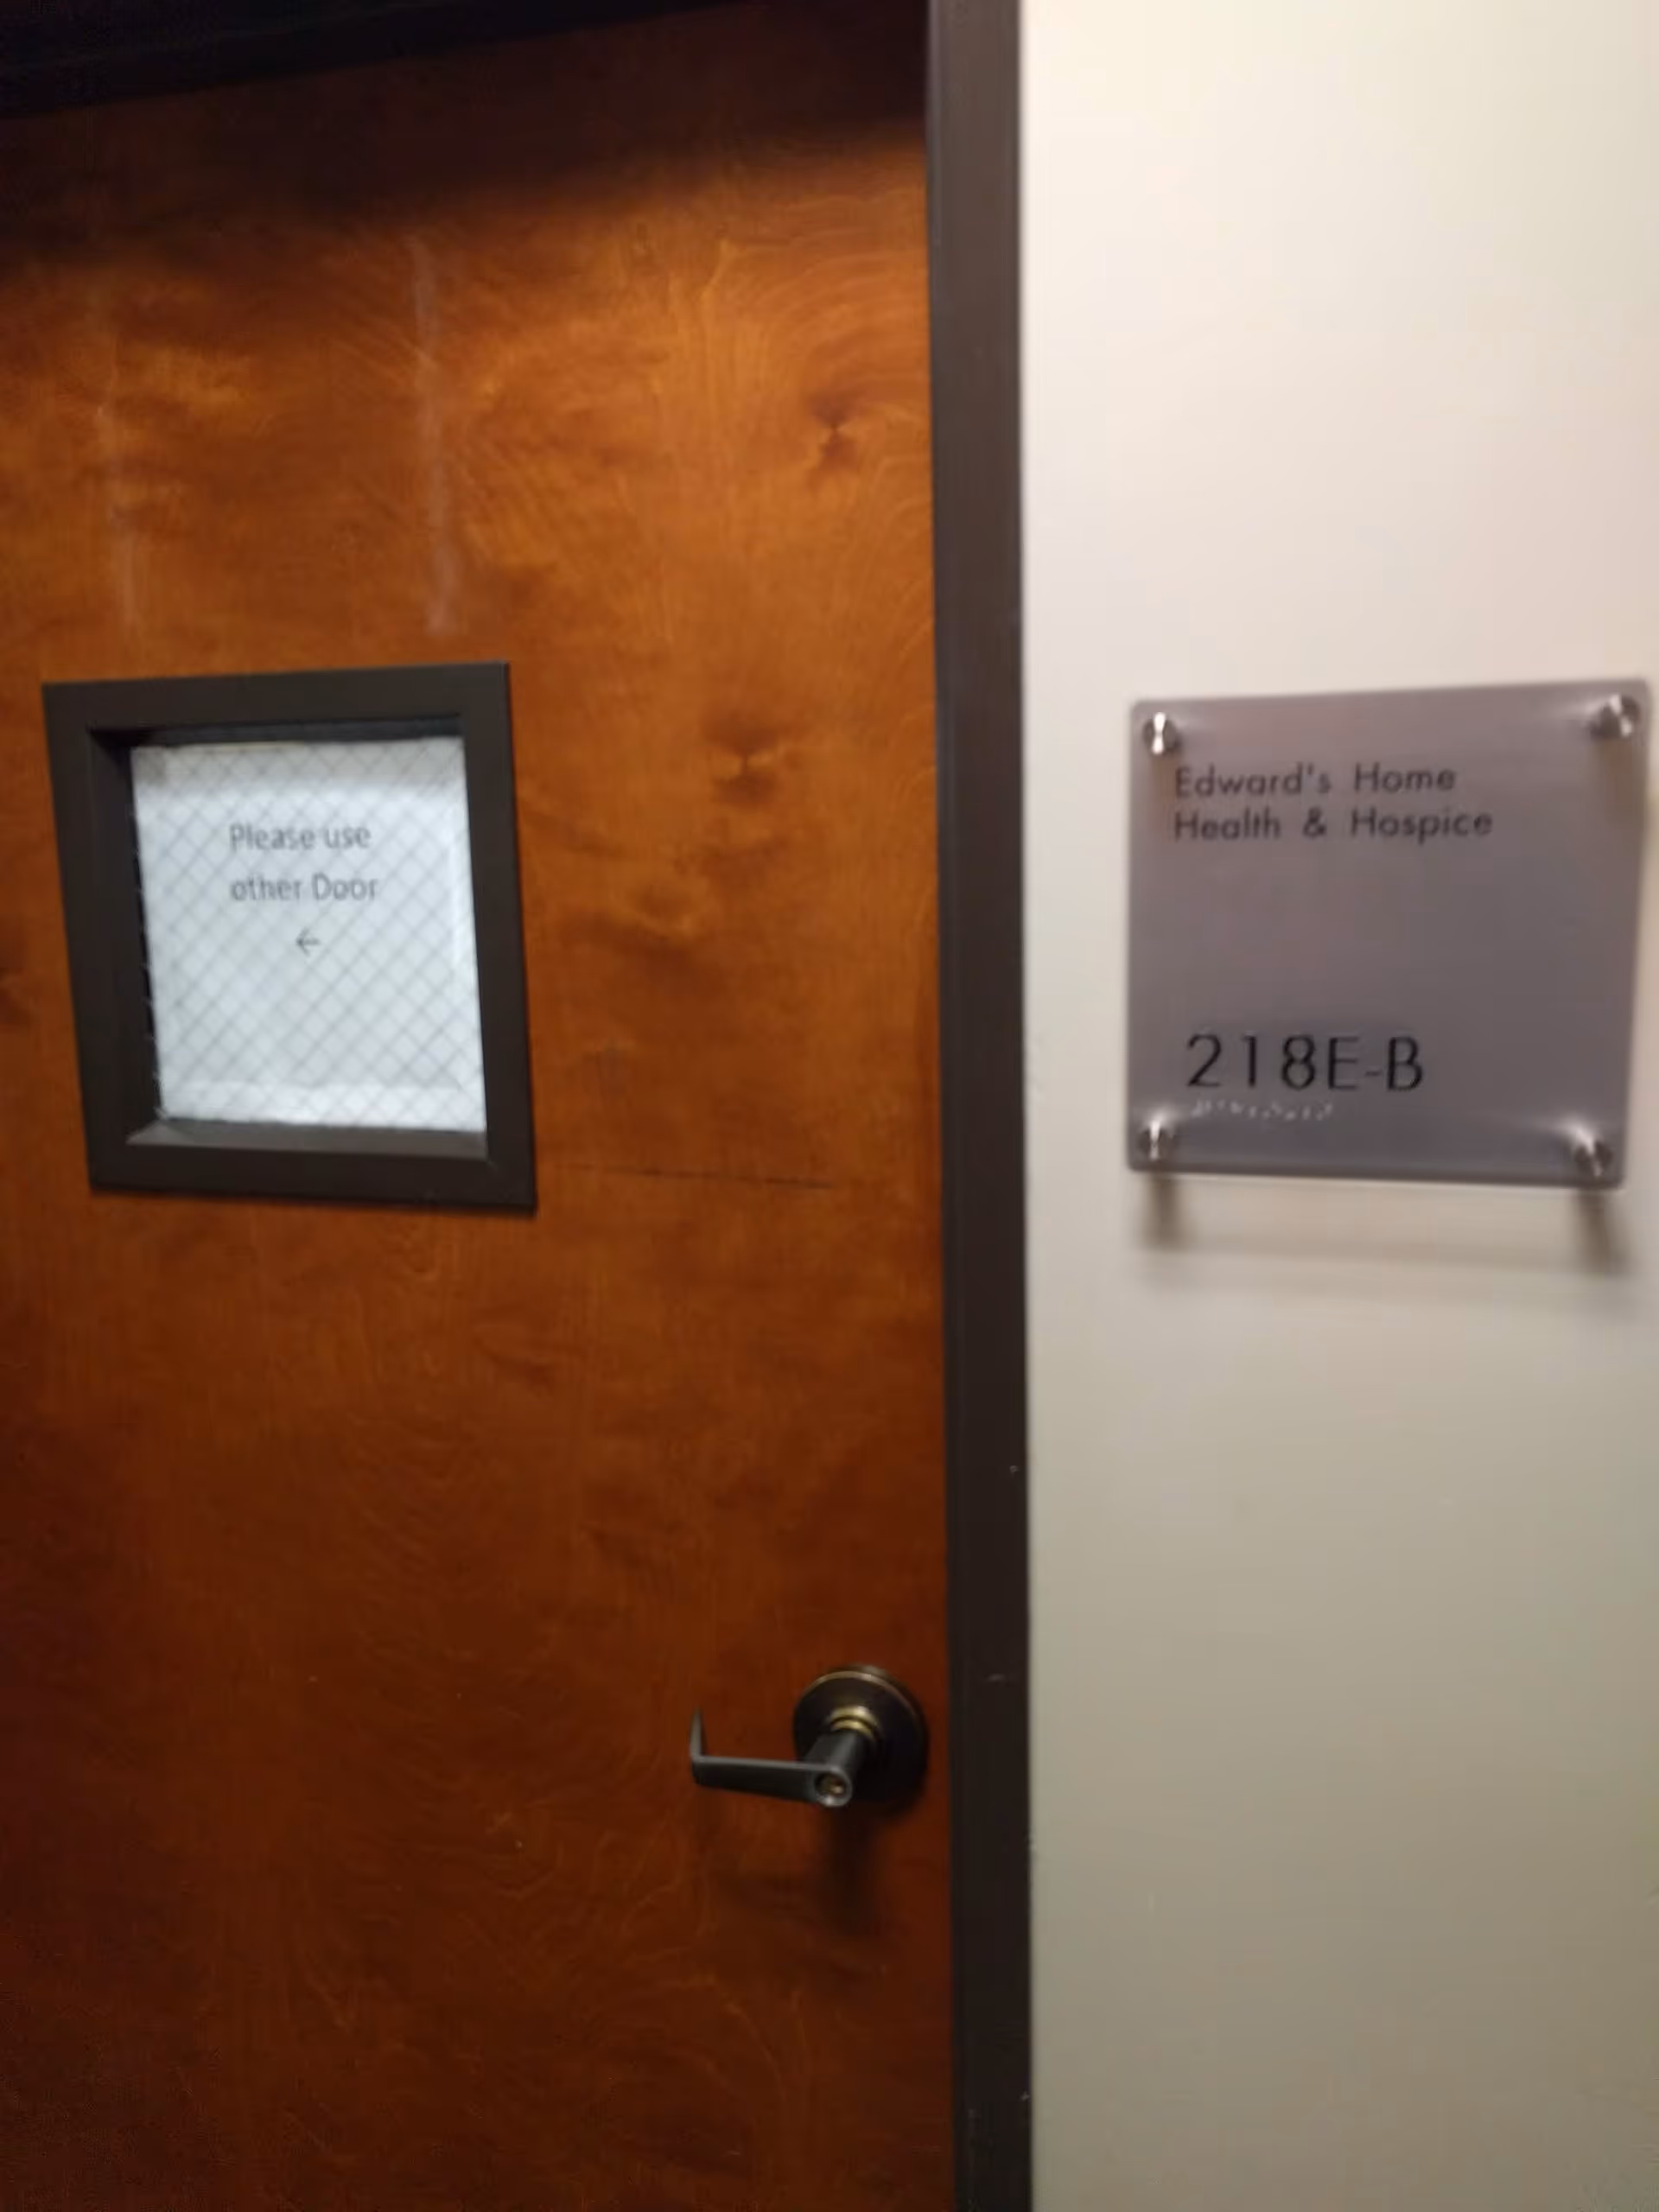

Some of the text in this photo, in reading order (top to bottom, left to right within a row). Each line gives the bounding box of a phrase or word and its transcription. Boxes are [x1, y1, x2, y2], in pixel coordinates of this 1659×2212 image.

[1175, 762, 1456, 798] Edward's Home
[230, 822, 372, 852] Please use
[1174, 806, 1493, 844] Health & Hospice
[230, 872, 378, 901] other Door
[1186, 1033, 1424, 1091] 218E-B
